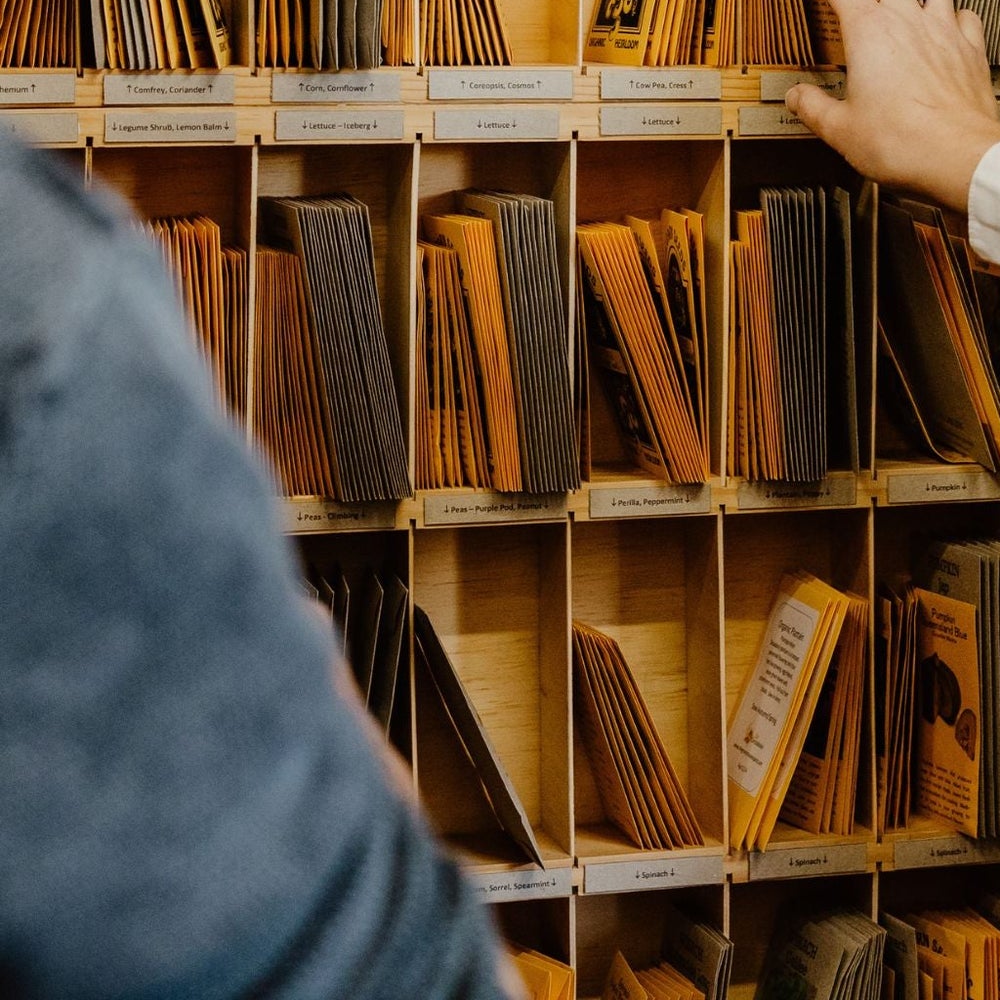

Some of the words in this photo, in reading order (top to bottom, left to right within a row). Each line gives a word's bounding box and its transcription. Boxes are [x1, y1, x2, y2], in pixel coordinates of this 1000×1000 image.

[134, 86, 167, 95] Comfrey,
[169, 85, 206, 94] Coriander
[305, 84, 325, 93] Corn,
[327, 83, 367, 92] Cornflower
[469, 81, 506, 91] Coreopsis,
[507, 82, 535, 90] Cosmos
[652, 81, 667, 90] Pea,
[344, 122, 371, 131] Iceberg
[484, 121, 510, 129] Lettuce
[648, 118, 674, 126] Lettuce
[119, 124, 148, 132] Legume
[203, 123, 222, 131] Balm
[931, 483, 961, 492] Pumpkin
[618, 499, 642, 508] Perilla,
[643, 497, 684, 508] Peppermint
[451, 506, 468, 514] Peas
[475, 505, 498, 515] Purple
[499, 504, 516, 513] Pod,
[517, 502, 542, 511] Peanut
[304, 513, 322, 521] Peas
[795, 858, 822, 868] Spinach
[641, 870, 668, 880] Spinach
[489, 884, 512, 893] Sorrel,
[514, 880, 550, 891] Spearmint
